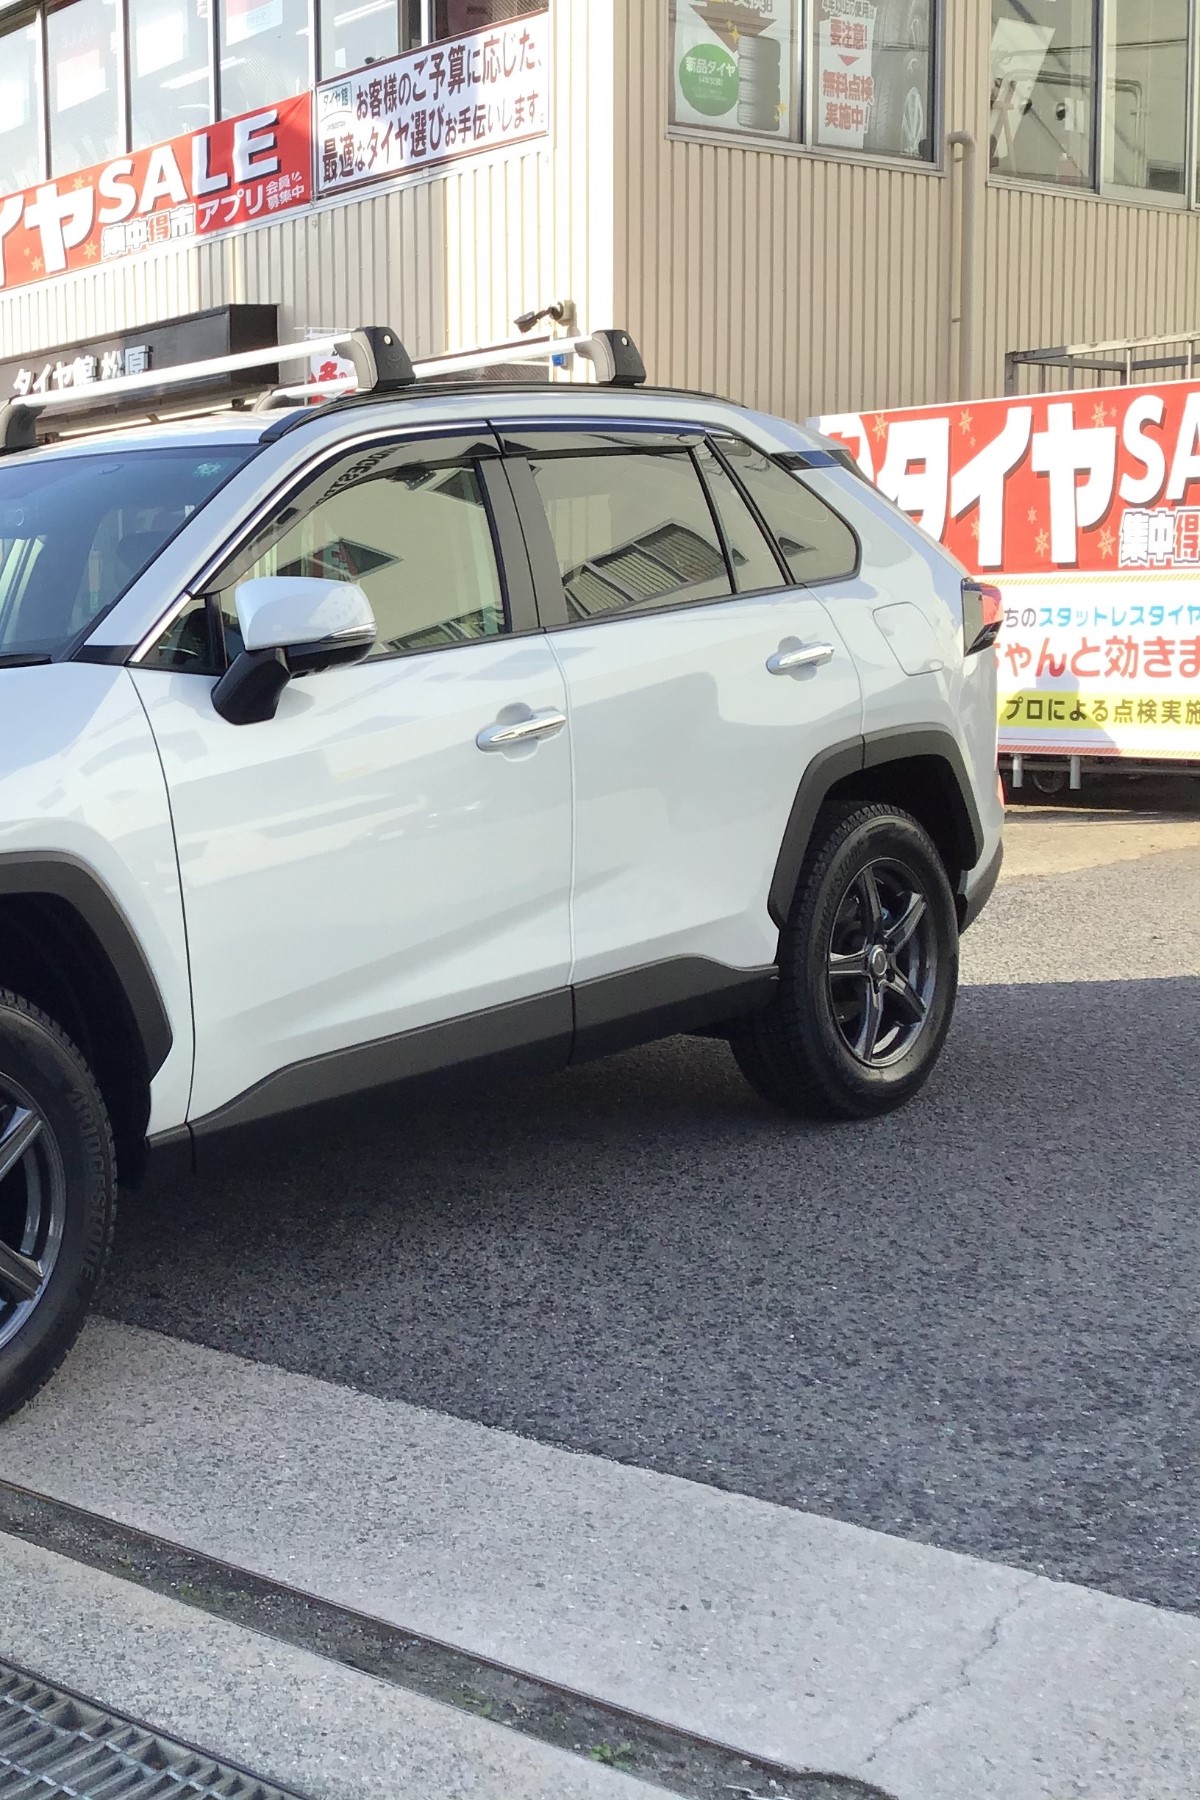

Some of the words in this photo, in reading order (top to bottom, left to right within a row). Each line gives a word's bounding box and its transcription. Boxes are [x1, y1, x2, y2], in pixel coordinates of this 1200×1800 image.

[356, 27, 542, 121] お客様のご予算に応じた、
[685, 56, 736, 77] 新品タイヤ
[823, 69, 874, 104] 無料点検
[322, 90, 544, 183] 最適なタイヤ選びお手伝いします。
[825, 101, 869, 133] 実施中!
[198, 185, 263, 230] アプリ
